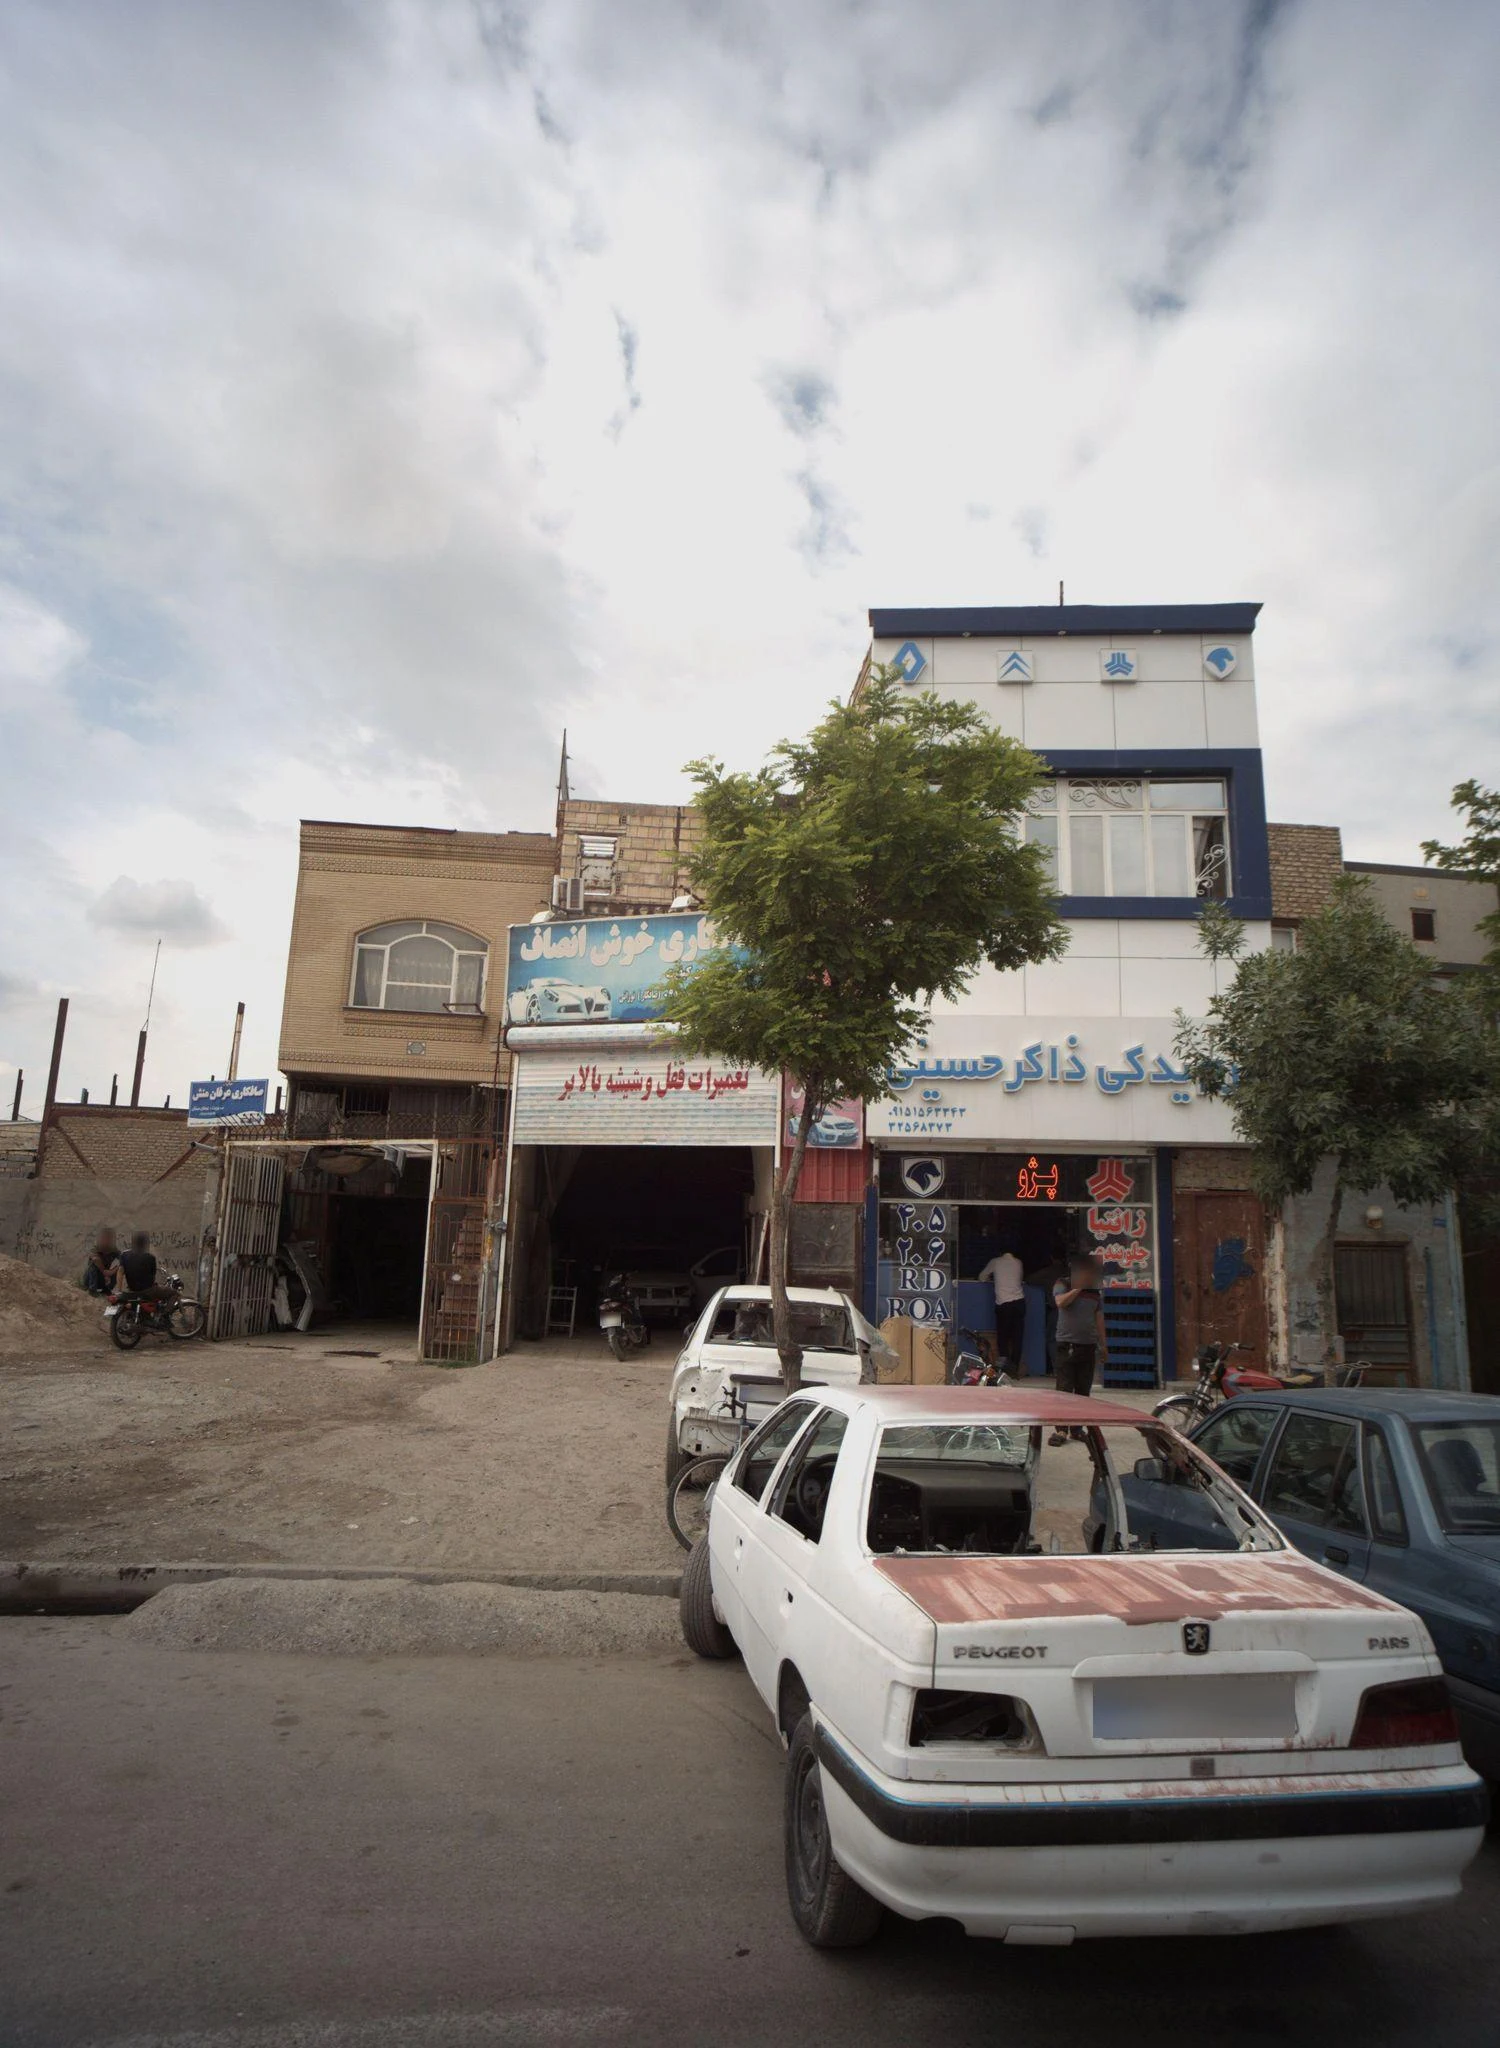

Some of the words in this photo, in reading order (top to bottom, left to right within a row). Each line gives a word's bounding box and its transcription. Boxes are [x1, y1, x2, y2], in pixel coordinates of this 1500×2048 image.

[520, 924, 587, 961] انصاف
[590, 921, 655, 967] خوش
[656, 1061, 686, 1098] قفل
[688, 1066, 750, 1100] تعمیرات
[1017, 1156, 1058, 1200] پژو
[897, 1203, 946, 1233] ۴۰۵
[1088, 1206, 1147, 1241] زانتیا
[896, 1236, 946, 1267] ۲۰۶
[899, 1267, 947, 1292] RD
[886, 1297, 952, 1321] ROA
[953, 1645, 1048, 1659] PEUGEOT
[1368, 1636, 1410, 1651] PARS
